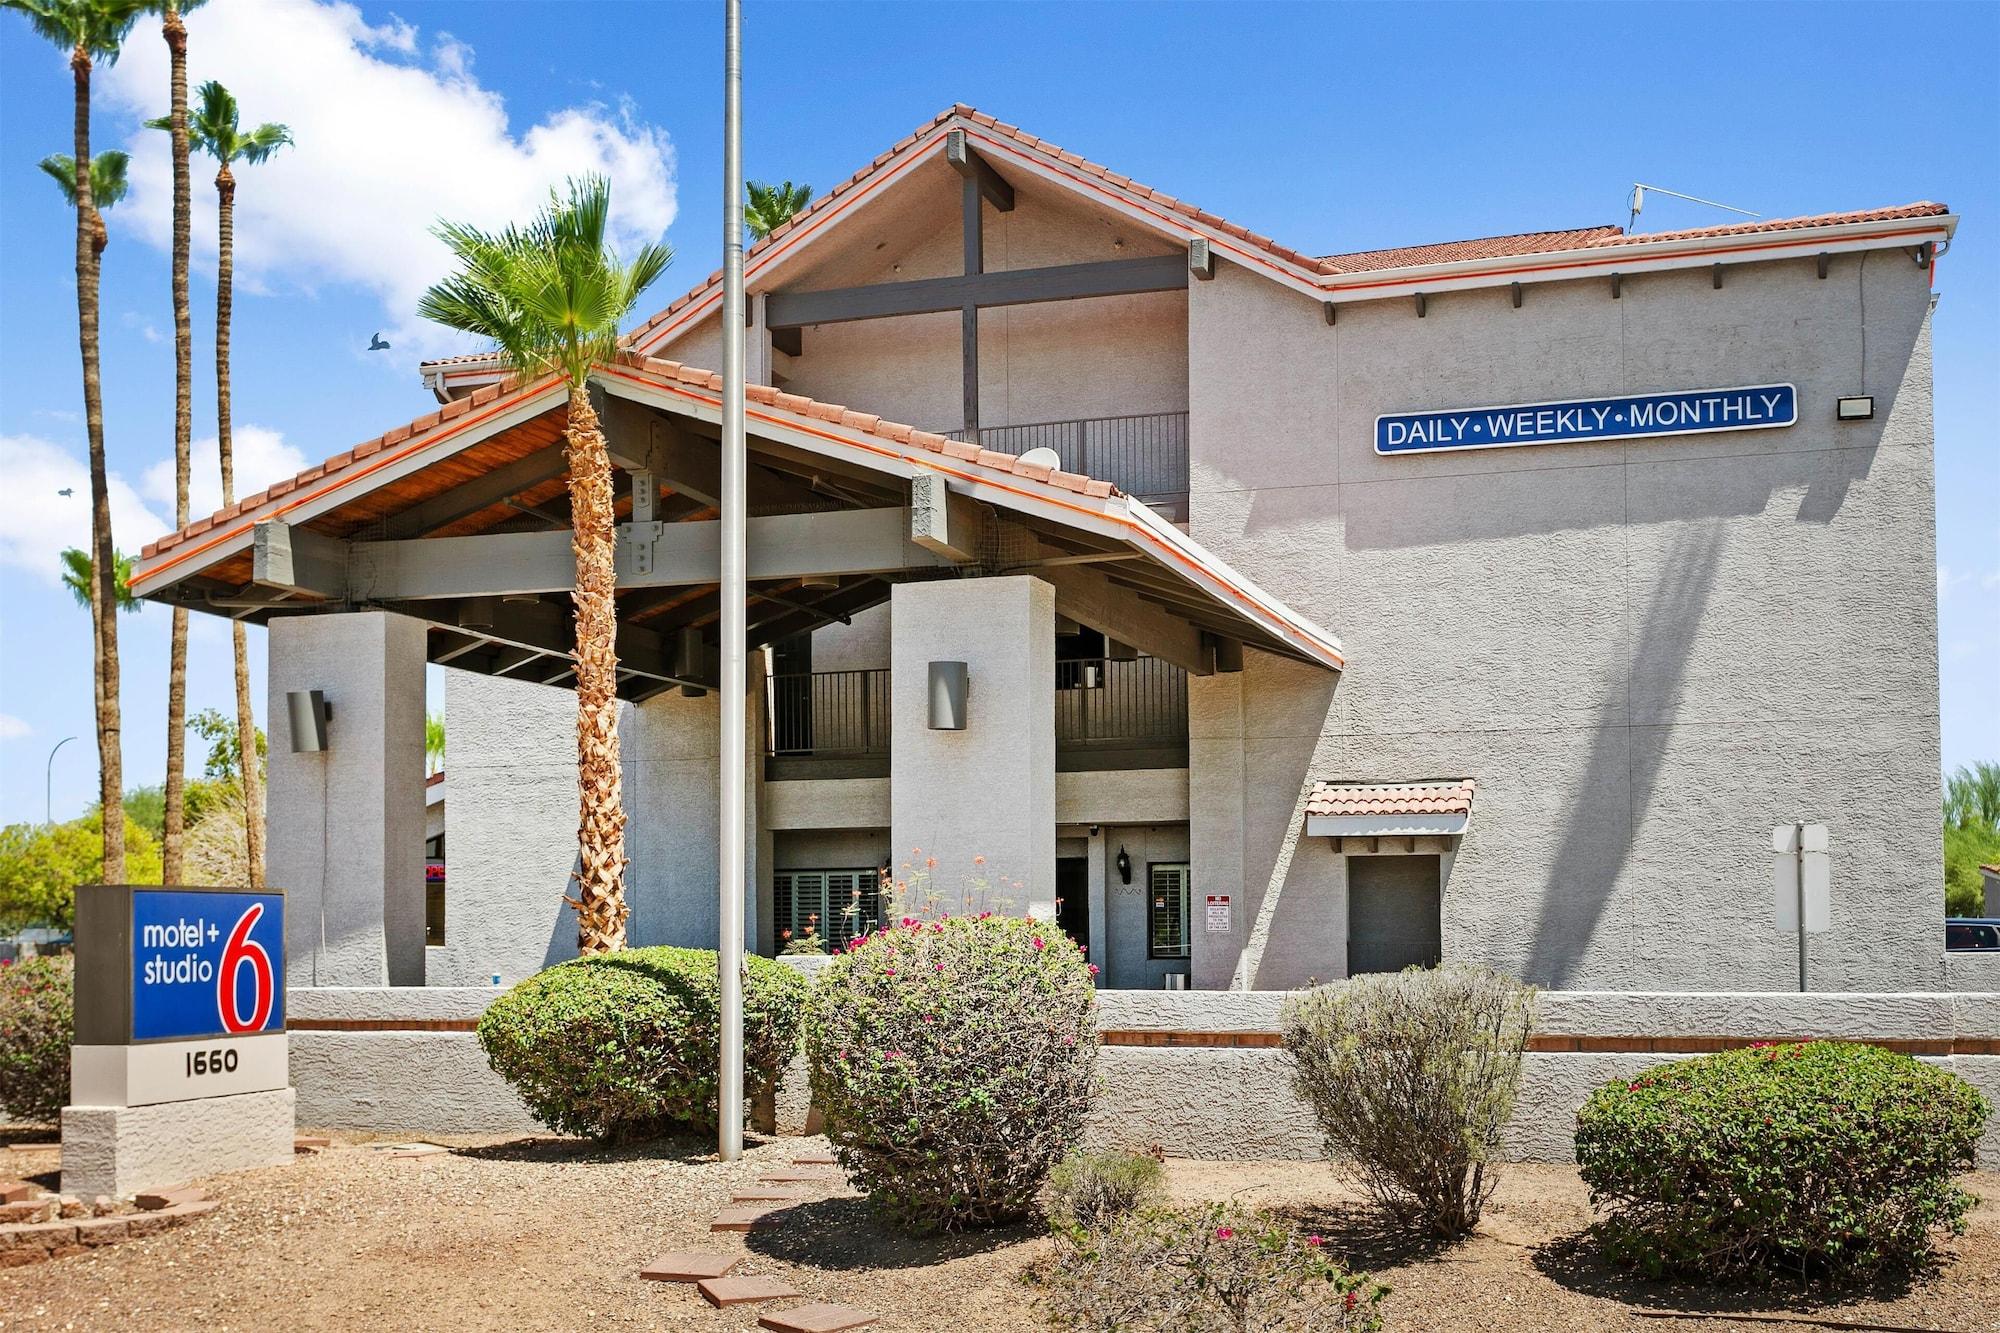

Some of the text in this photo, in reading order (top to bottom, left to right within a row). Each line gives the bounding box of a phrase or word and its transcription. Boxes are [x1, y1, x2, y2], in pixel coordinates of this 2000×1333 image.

[1387, 393, 1782, 445] DAILY WEEKLY MONTHLY
[143, 953, 213, 985] studio
[216, 902, 275, 1034] 6
[186, 1048, 238, 1078] 1660
